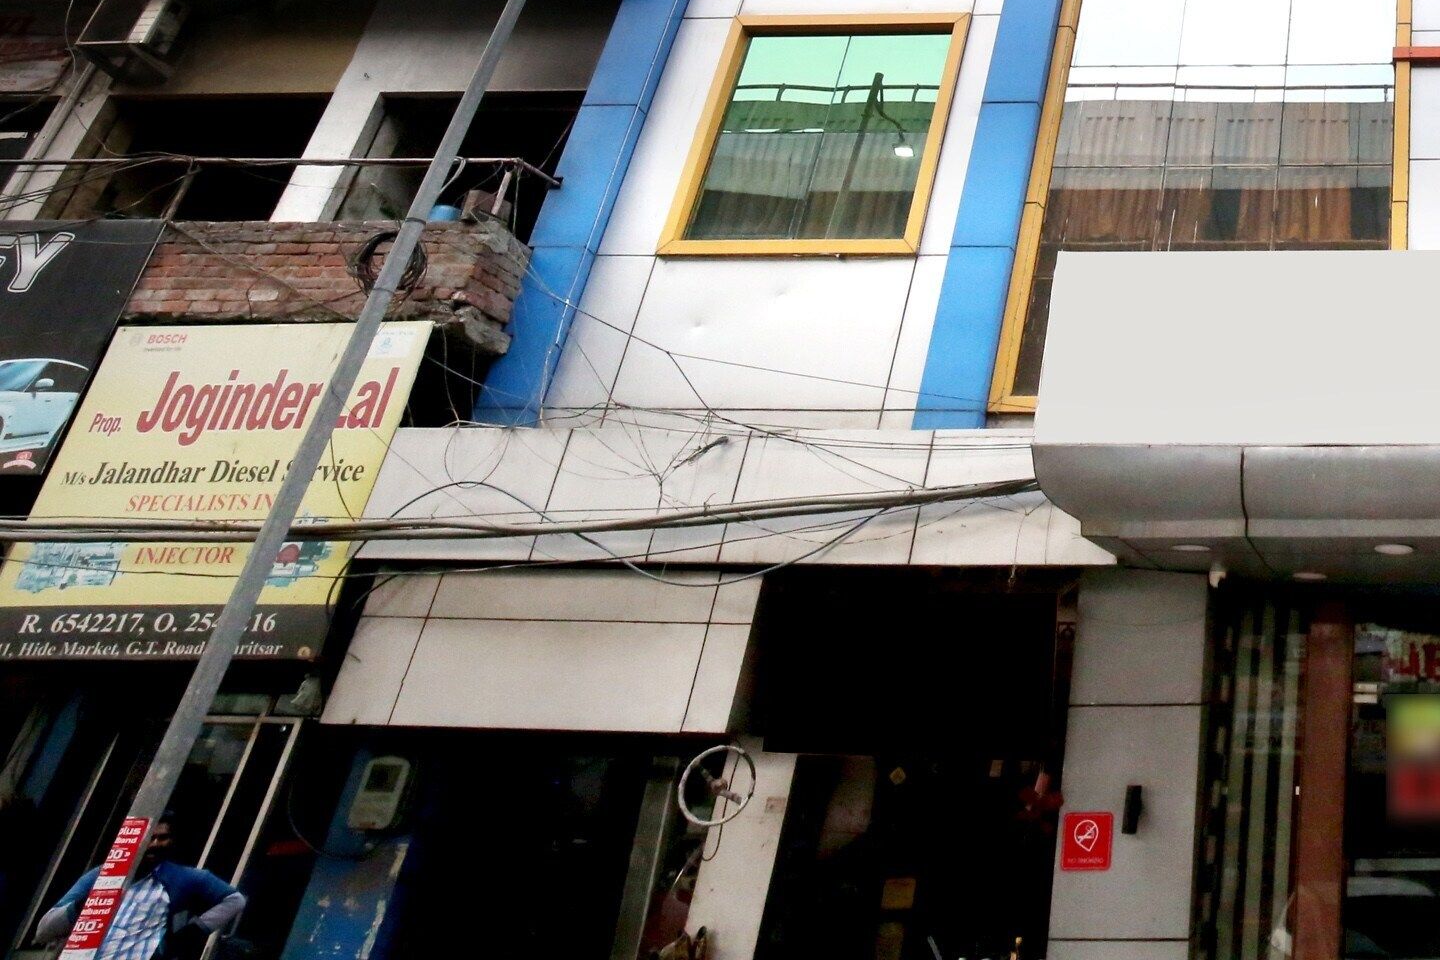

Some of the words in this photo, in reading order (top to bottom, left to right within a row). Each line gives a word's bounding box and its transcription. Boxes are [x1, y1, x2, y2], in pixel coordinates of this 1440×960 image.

[147, 334, 188, 344] BOSCH
[88, 412, 122, 437] Prop.
[136, 369, 324, 446] Joginder
[60, 471, 86, 487] M/s
[88, 460, 206, 485] Jalandhar
[208, 458, 280, 484] Diesel
[125, 493, 249, 512] SPECIALISTS
[134, 546, 235, 565] INJECTOR
[18, 614, 42, 634] R.
[50, 613, 145, 637] 6542217,
[153, 612, 178, 632] O.
[18, 641, 56, 656] Hide
[125, 641, 158, 656] G.T.
